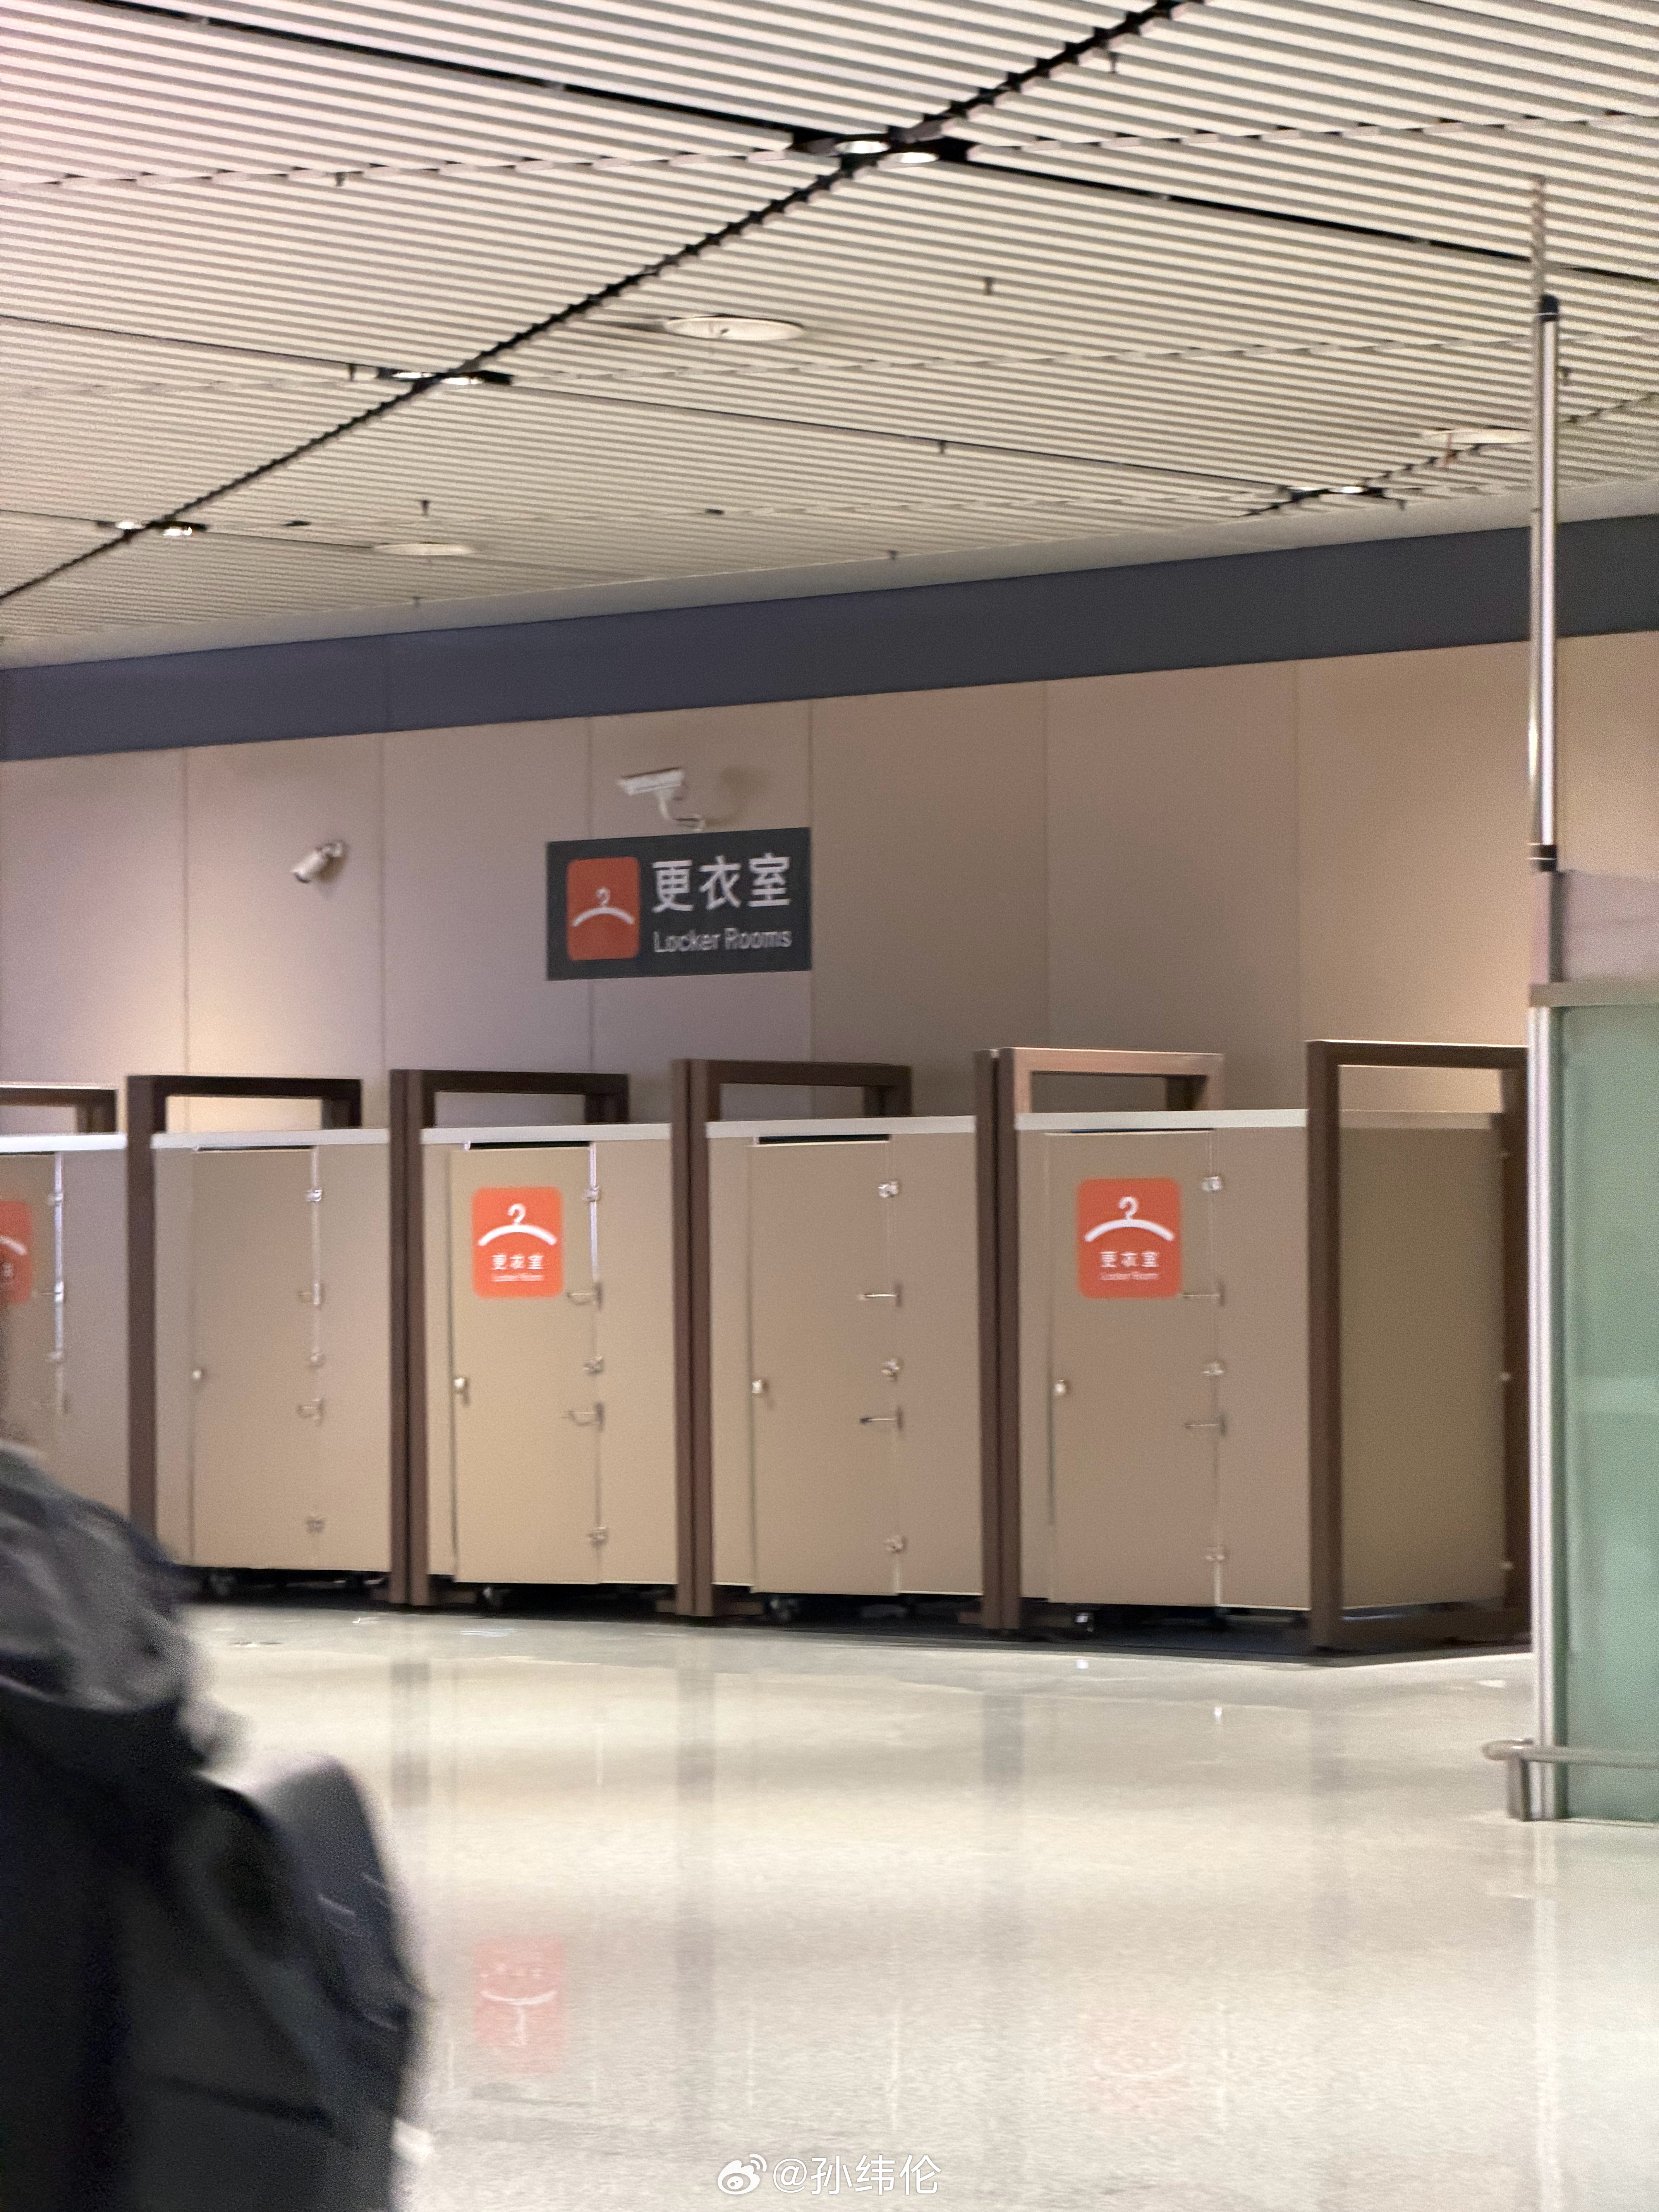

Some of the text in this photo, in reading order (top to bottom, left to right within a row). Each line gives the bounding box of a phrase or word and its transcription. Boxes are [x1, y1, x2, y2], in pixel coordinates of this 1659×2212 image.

[652, 853, 791, 913] 更衣室
[653, 927, 793, 952] Locker Rooms
